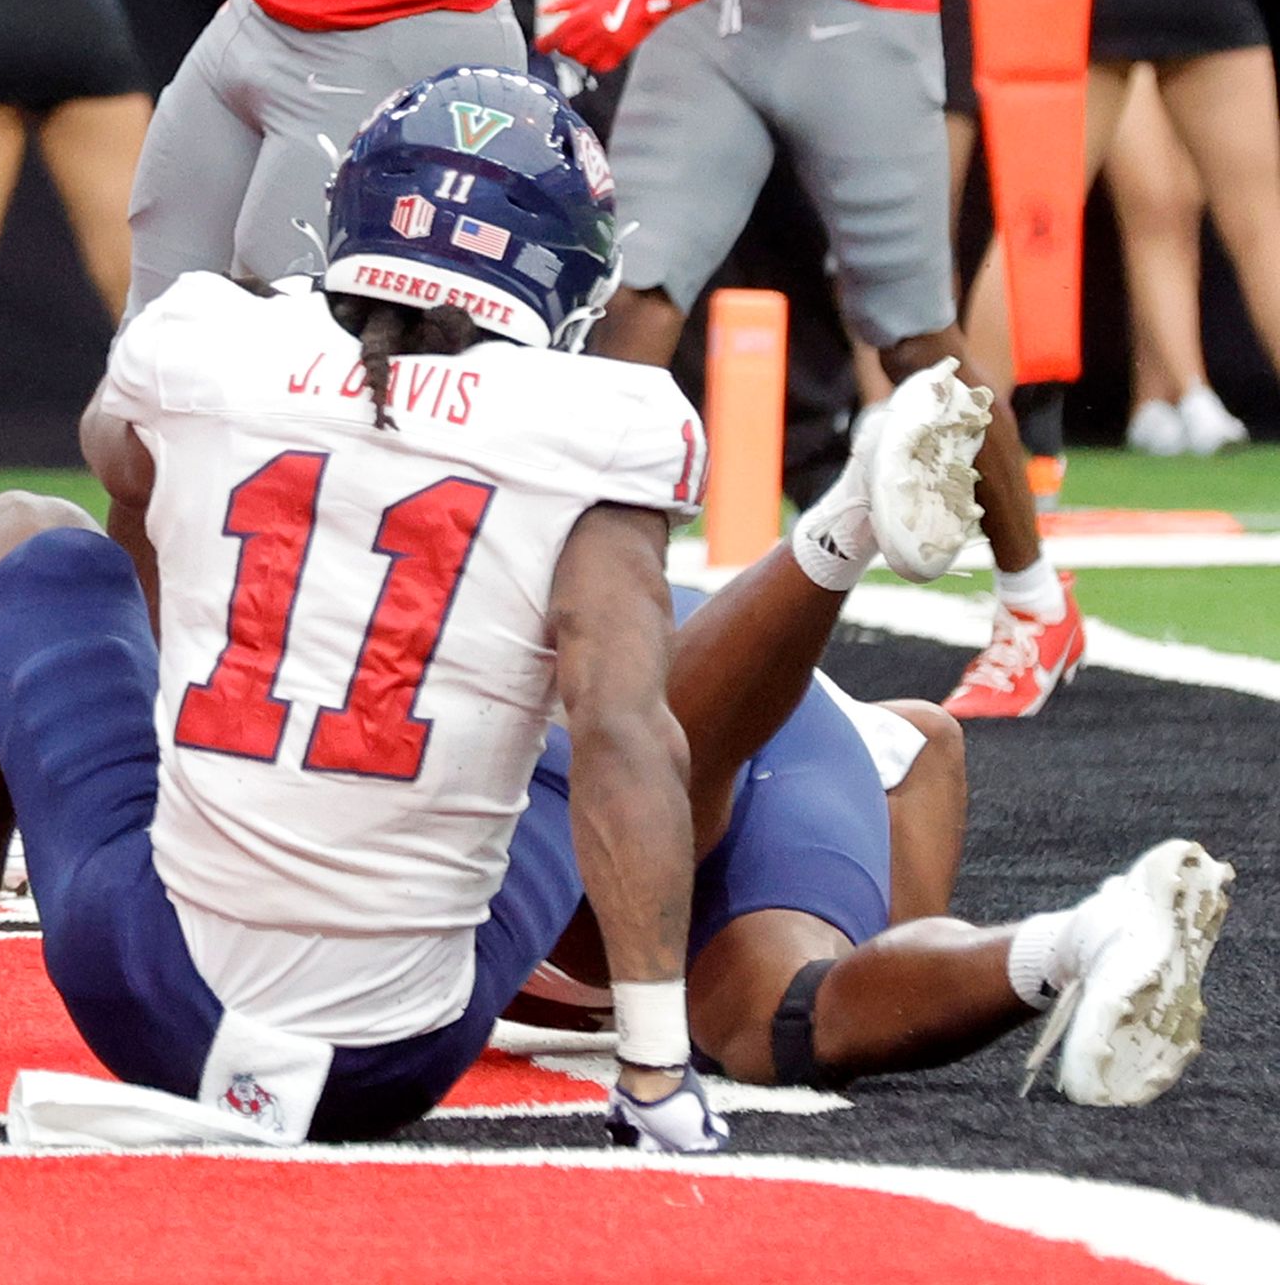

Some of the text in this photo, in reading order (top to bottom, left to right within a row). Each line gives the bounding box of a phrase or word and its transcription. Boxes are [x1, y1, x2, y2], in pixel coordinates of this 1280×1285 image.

[448, 100, 515, 155] V
[433, 169, 476, 204] 11
[353, 265, 516, 328] FRESNO STATE
[287, 352, 326, 396] J.
[173, 448, 498, 782] 11
